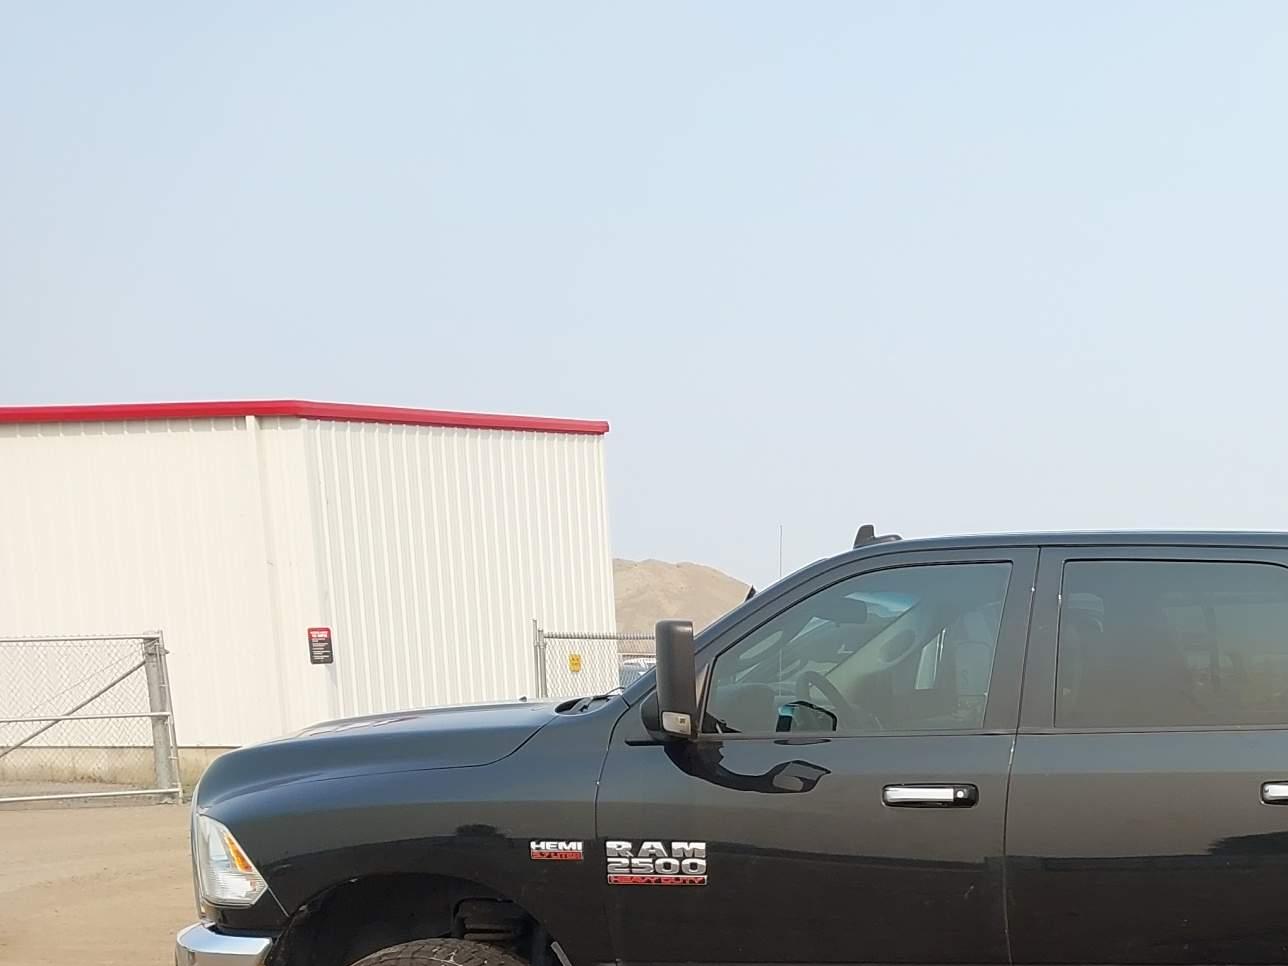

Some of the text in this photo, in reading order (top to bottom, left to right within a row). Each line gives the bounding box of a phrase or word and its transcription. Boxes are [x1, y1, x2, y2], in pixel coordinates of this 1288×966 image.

[530, 841, 583, 851] HEMI
[606, 841, 706, 858] RAM
[607, 858, 707, 874] 2500
[609, 875, 705, 885] HEAVY DUTY
